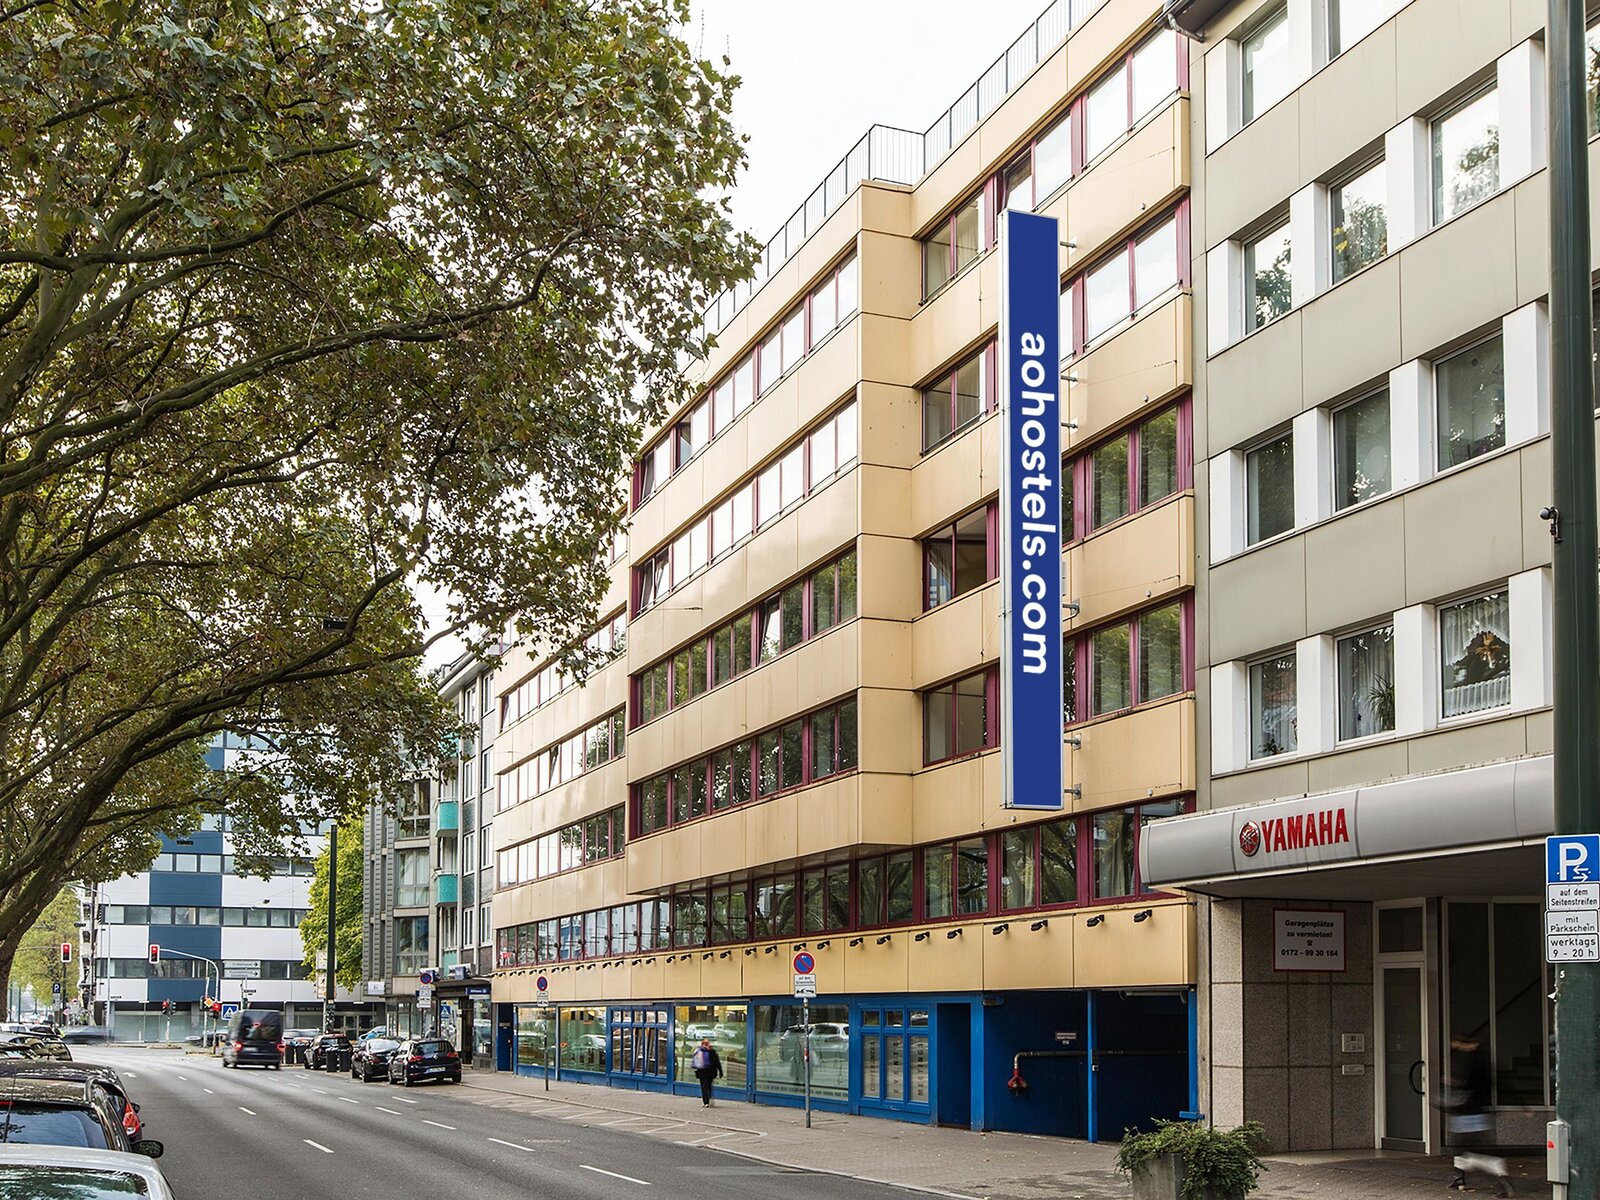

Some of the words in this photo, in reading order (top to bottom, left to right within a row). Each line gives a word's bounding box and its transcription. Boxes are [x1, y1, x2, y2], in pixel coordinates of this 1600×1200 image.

[1020, 332, 1057, 675] aohostels.com
[1261, 808, 1349, 853] YAMAHA
[1559, 842, 1588, 881] P
[1559, 888, 1571, 897] auf
[1573, 888, 1589, 897] dem
[1550, 897, 1598, 907] Seitenstreifen
[1284, 919, 1335, 928] Garagenplätze
[1565, 915, 1579, 924] mit
[1550, 924, 1596, 933] Parkschein
[1296, 930, 1333, 938] vermieten!
[1550, 937, 1597, 949] werktags
[1552, 949, 1559, 958] 9
[1572, 949, 1584, 958] 20
[1588, 948, 1594, 957] h
